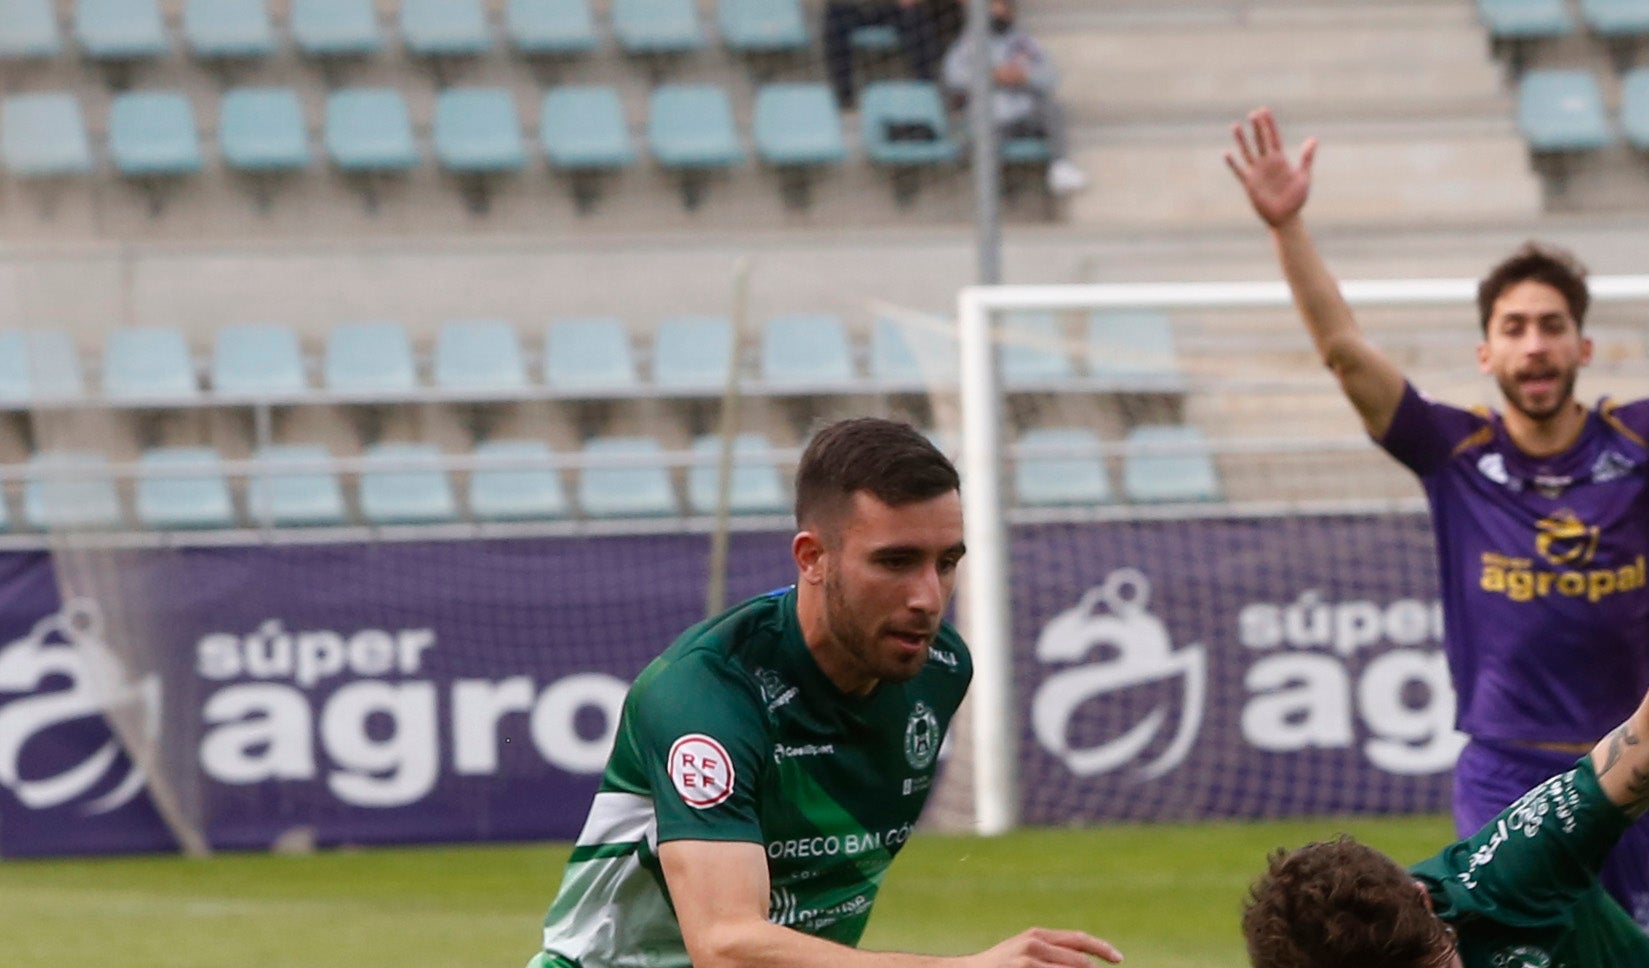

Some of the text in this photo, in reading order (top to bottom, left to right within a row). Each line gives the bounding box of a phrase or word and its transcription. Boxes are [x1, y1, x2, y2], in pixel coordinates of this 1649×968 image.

[1480, 556, 1647, 602] agropal
[200, 618, 435, 682] súper
[767, 835, 840, 859] ORECO
